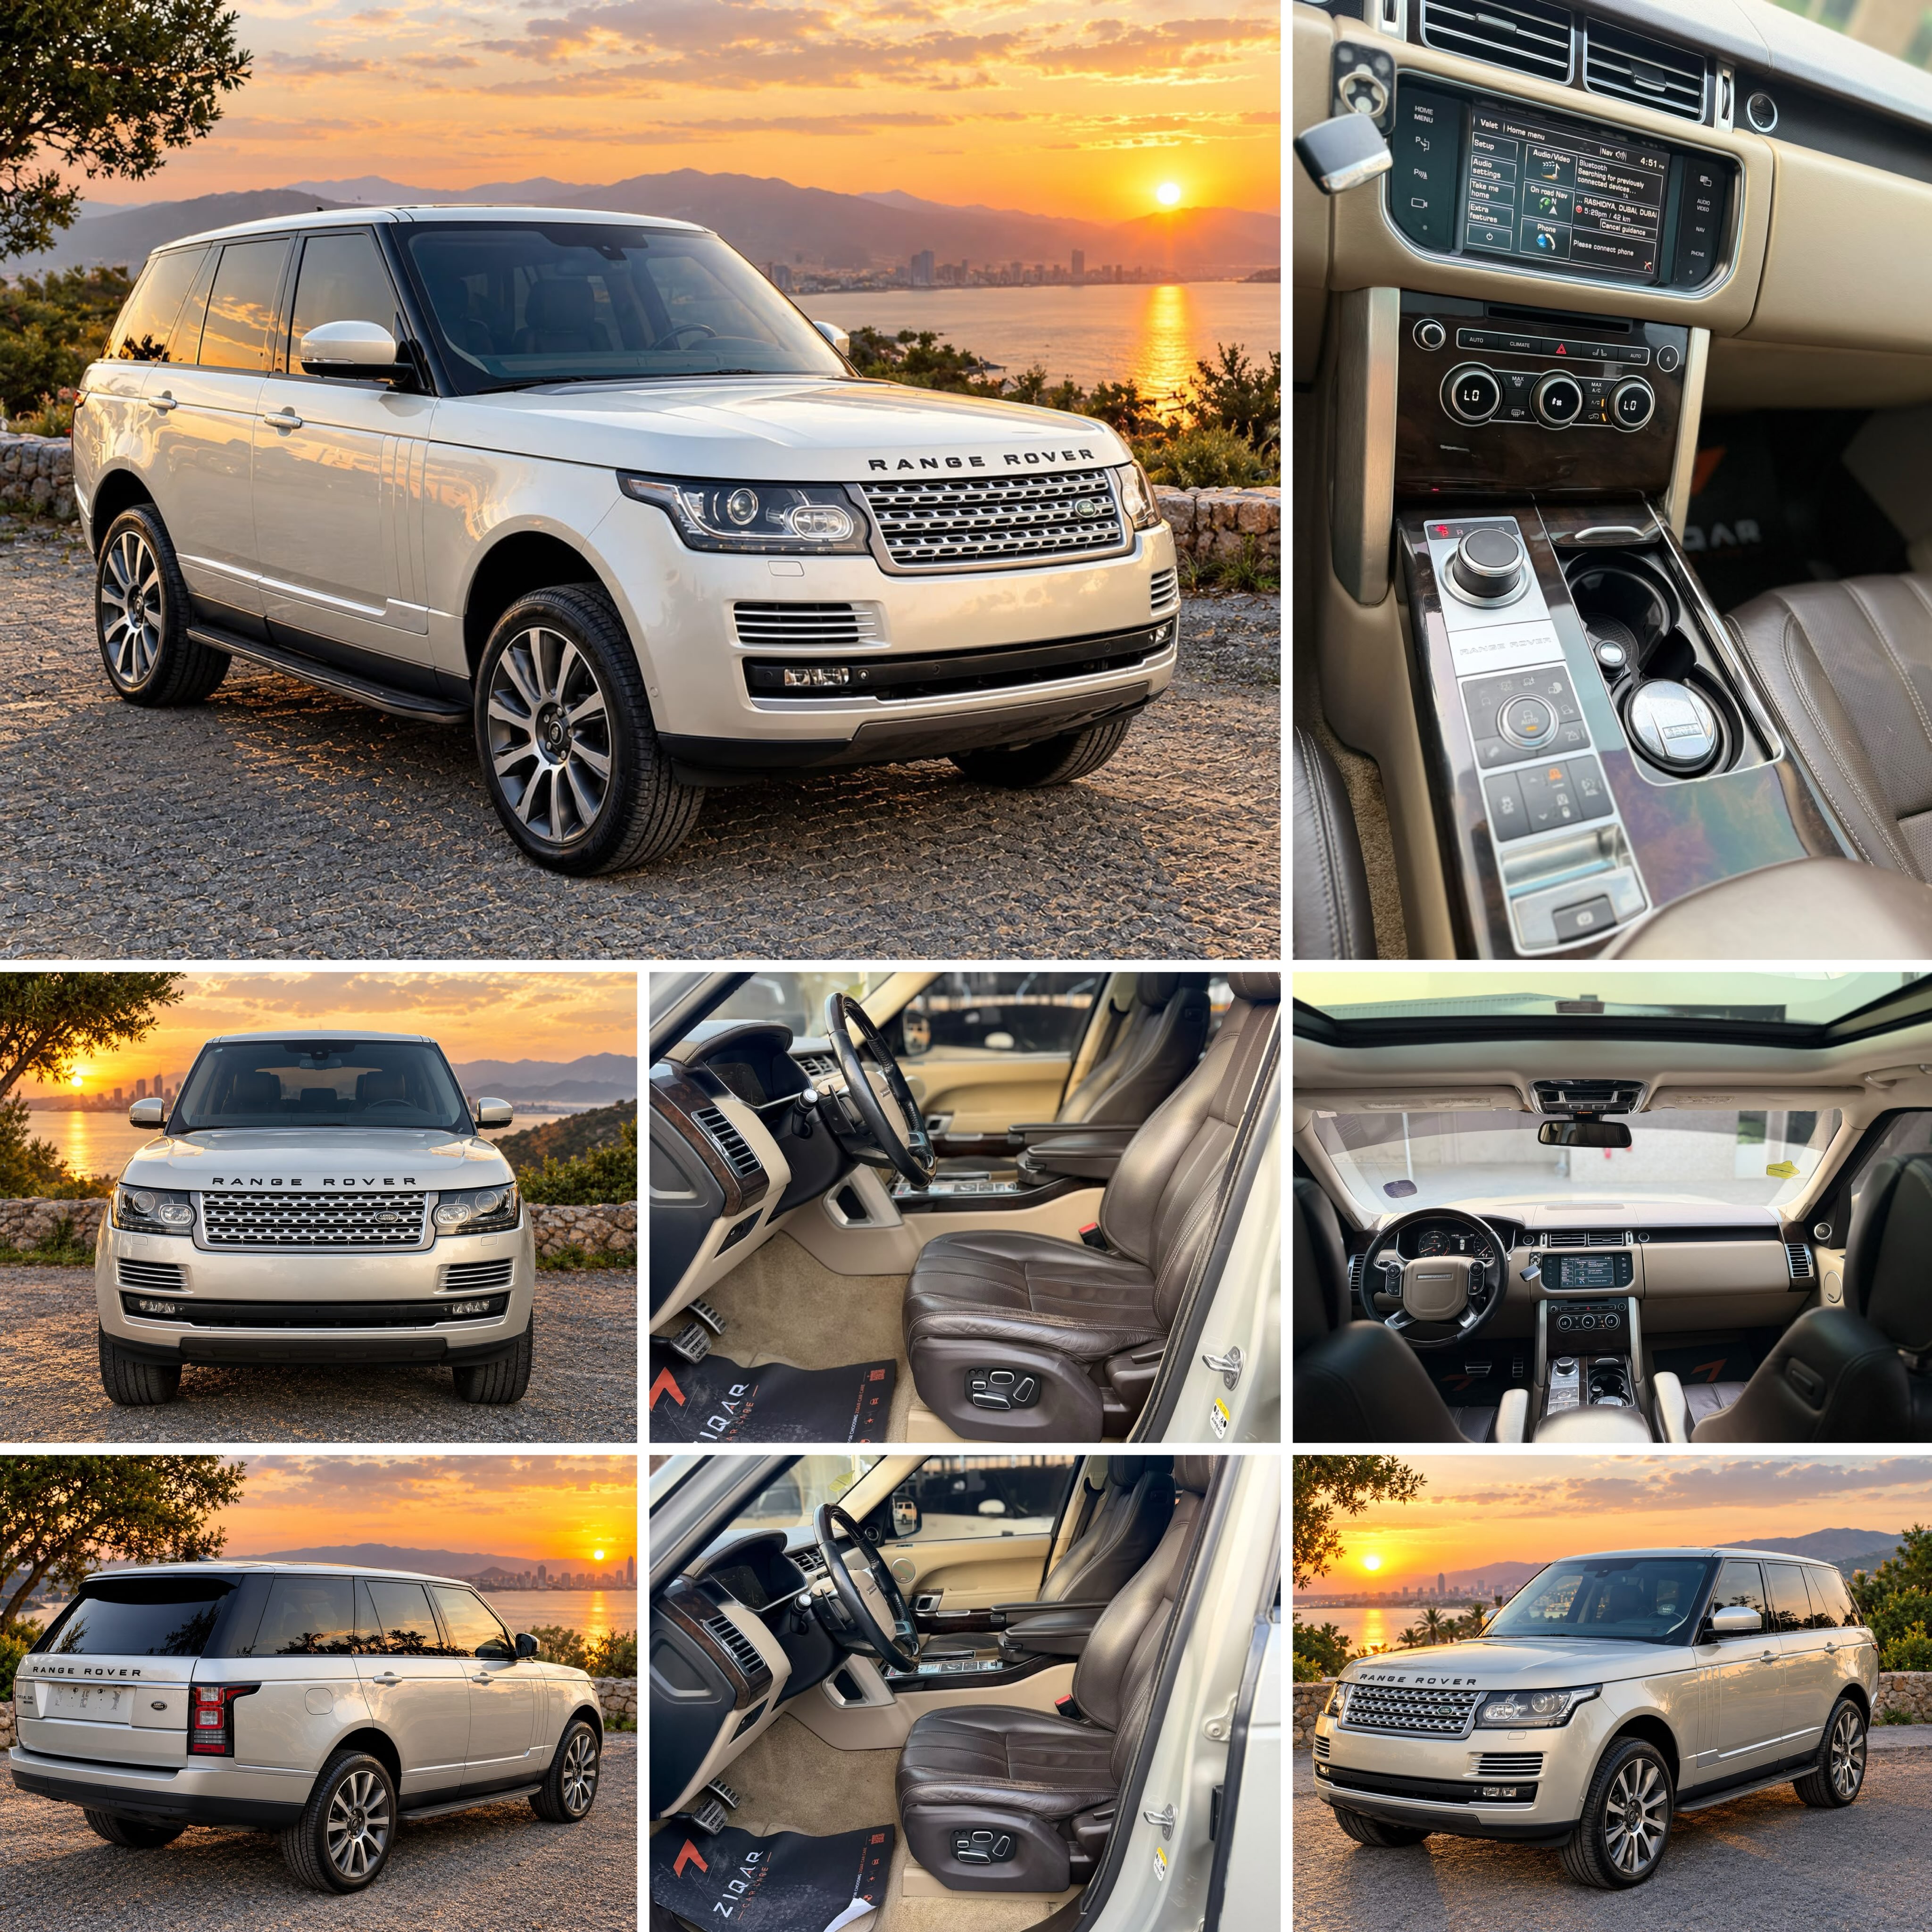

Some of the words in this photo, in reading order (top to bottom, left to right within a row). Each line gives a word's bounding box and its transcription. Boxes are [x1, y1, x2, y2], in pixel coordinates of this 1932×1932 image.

[1415, 105, 1433, 115] HOME
[1414, 114, 1433, 123] MENU
[1480, 119, 1499, 129] Valet
[1507, 125, 1526, 136] Home
[1527, 130, 1545, 141] menu
[1474, 139, 1494, 150] Setup
[1533, 150, 1570, 163] Audio/Video
[1601, 148, 1613, 157] Nav
[1473, 158, 1492, 168] Audio
[1579, 159, 1607, 172] Bluetooth
[1640, 157, 1657, 167] 4:51
[1473, 168, 1501, 179] settings
[1578, 167, 1606, 181] Searching
[1607, 174, 1616, 182] for
[1617, 177, 1645, 189] previously
[1472, 181, 1486, 190] Take
[1577, 177, 1607, 188] connected
[1609, 183, 1636, 194] devices...
[1471, 190, 1490, 199] home
[1470, 204, 1489, 213] Extra
[1584, 198, 1617, 211] RASHIDIYA,
[1618, 204, 1638, 215] DUBAI,
[1640, 208, 1657, 218] DUBAI
[1584, 208, 1607, 218] 5:29pm
[1470, 212, 1498, 223] features
[1537, 224, 1556, 233] Phone
[1601, 222, 1621, 231] Cancel
[1622, 226, 1646, 236] guidance
[1573, 240, 1592, 249] Please
[1593, 244, 1616, 253] connect
[1617, 248, 1634, 257] phone
[868, 456, 985, 471] RANGE
[1004, 449, 1095, 465] ROVER
[1460, 643, 1506, 655] RANGE
[1510, 638, 1551, 648] ROVER
[212, 1177, 302, 1186] RANGE
[323, 1177, 416, 1186] ROVER
[693, 1383, 749, 1443] IQAR
[735, 1401, 754, 1425] CARE
[849, 1414, 858, 1435] CHOOSING
[33, 1666, 74, 1674] RANGE
[84, 1668, 142, 1676] ROVER
[1360, 1674, 1406, 1682] RANGE
[1415, 1677, 1476, 1685] ROVER
[713, 1850, 764, 1918] ZIQAR
[742, 1890, 756, 1908] CAR
[754, 1866, 768, 1886] CARE
